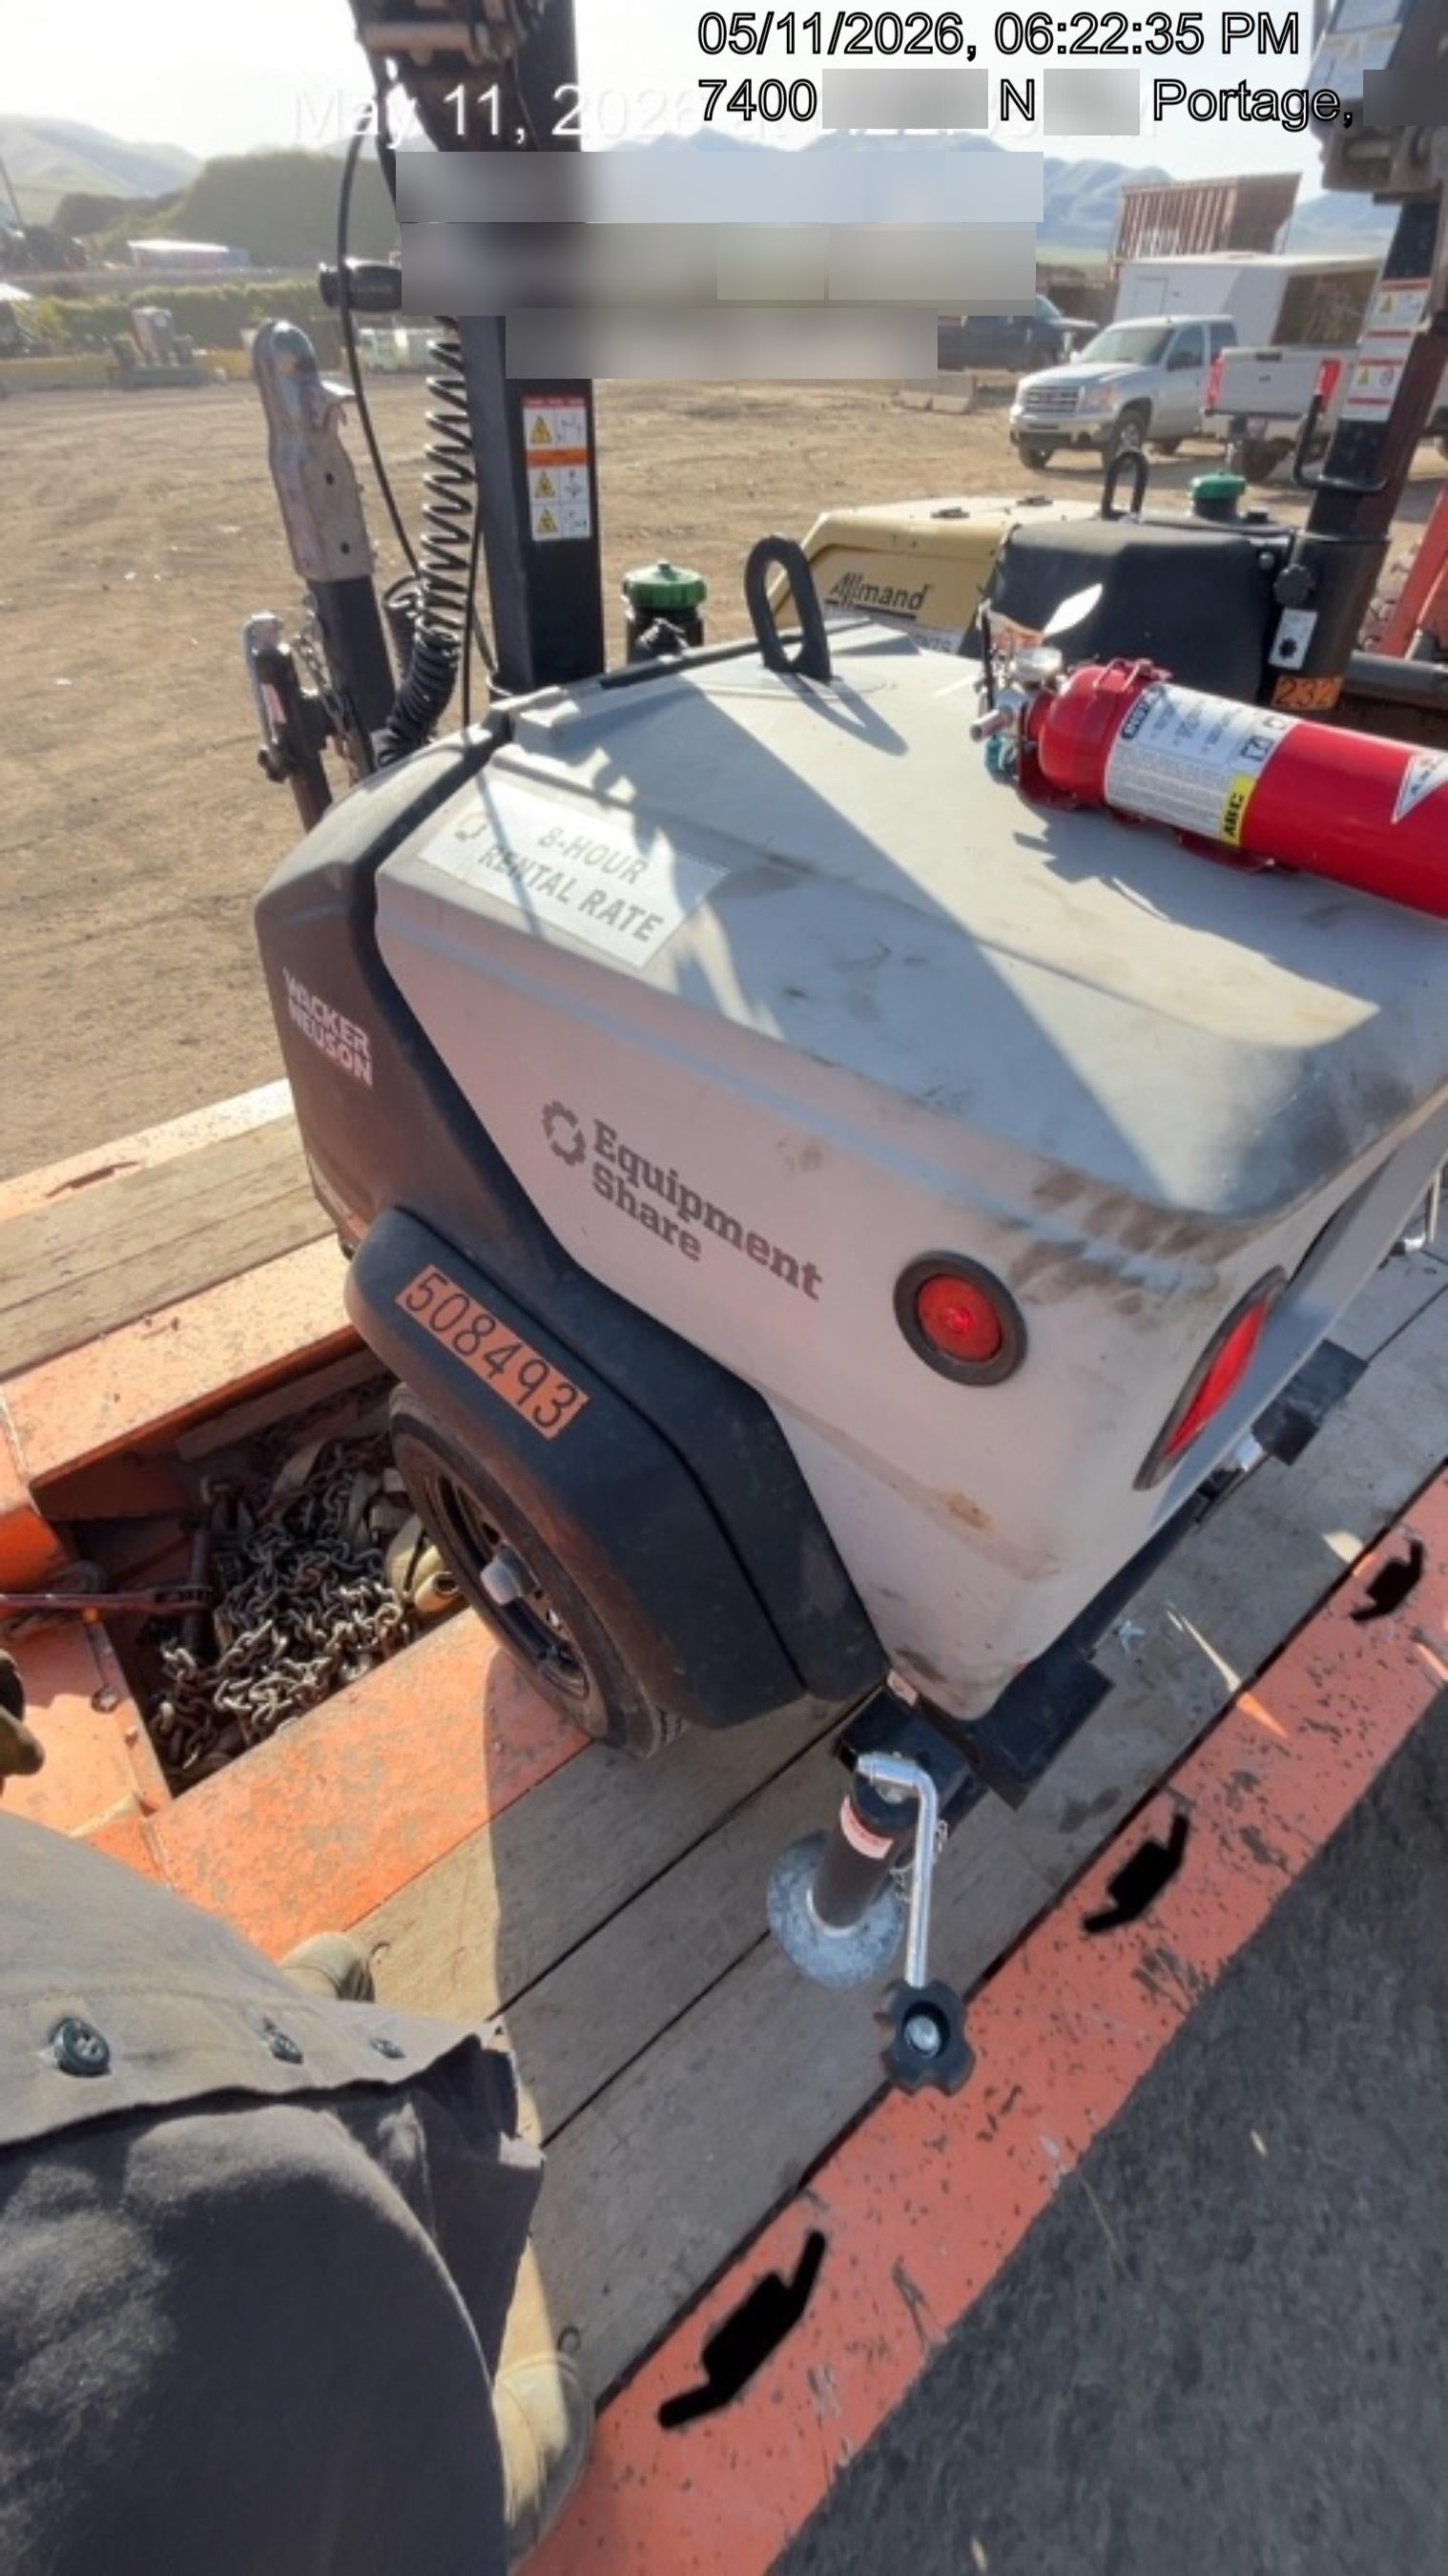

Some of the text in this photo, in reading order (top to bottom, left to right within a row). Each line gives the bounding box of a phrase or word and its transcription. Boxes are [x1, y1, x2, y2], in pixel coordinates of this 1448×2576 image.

[829, 571, 931, 613] Allmand
[478, 842, 665, 943] RENTAL RATE
[537, 825, 650, 885] 8-HOUR
[591, 1160, 702, 1262] Share
[593, 1117, 823, 1302] Equipment
[405, 1272, 578, 1428] 508493
